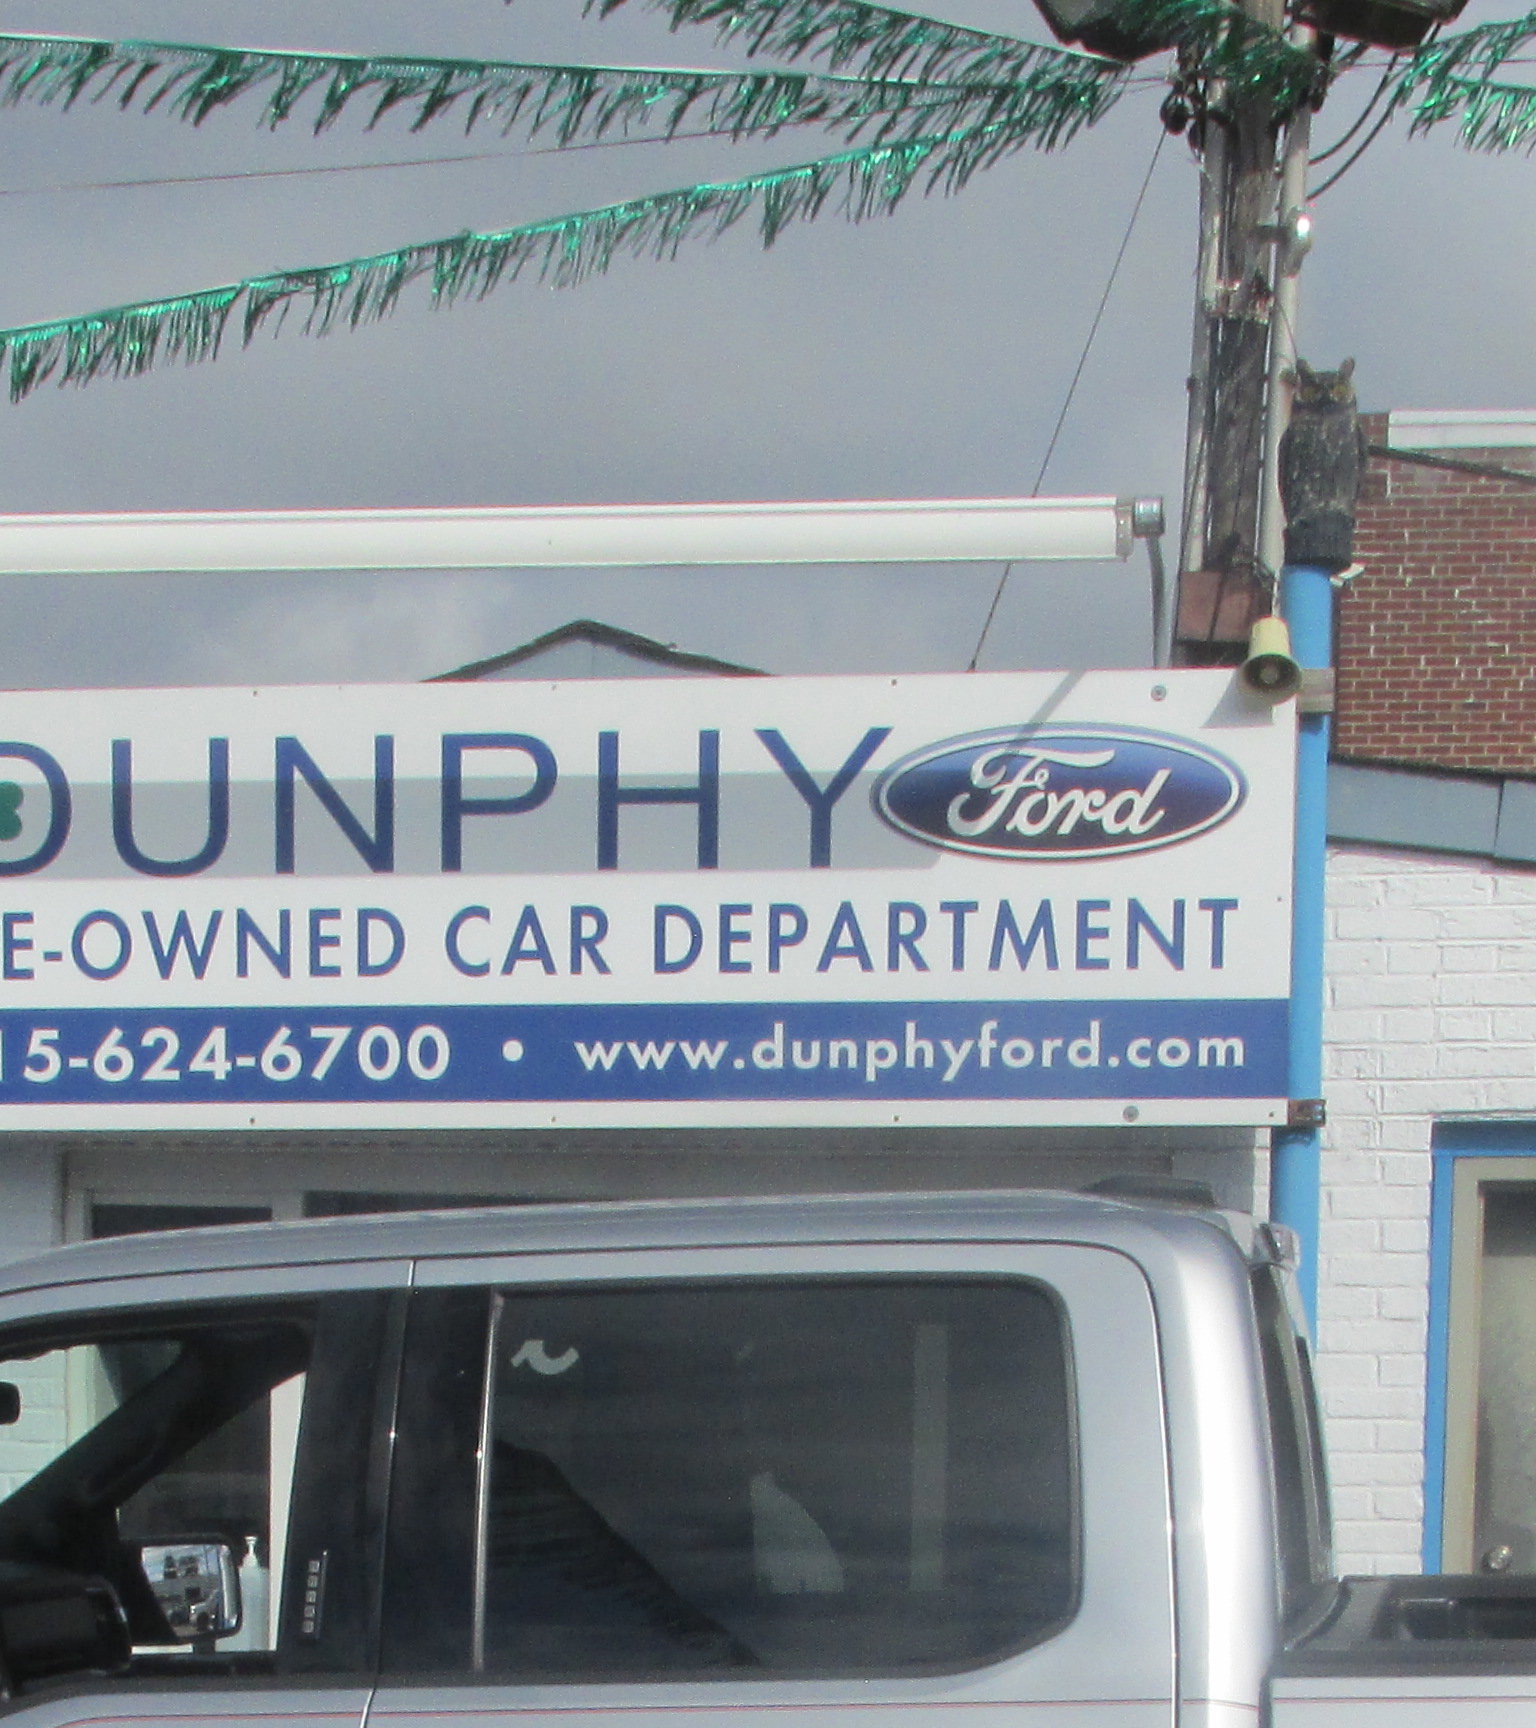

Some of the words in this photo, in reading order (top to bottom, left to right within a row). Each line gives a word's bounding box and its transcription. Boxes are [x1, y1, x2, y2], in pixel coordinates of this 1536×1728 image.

[947, 746, 1172, 836] Ford
[445, 904, 612, 977] CAR
[653, 898, 1240, 975] DEPARTMENT
[575, 1020, 1246, 1083] www.dunphyford.com
